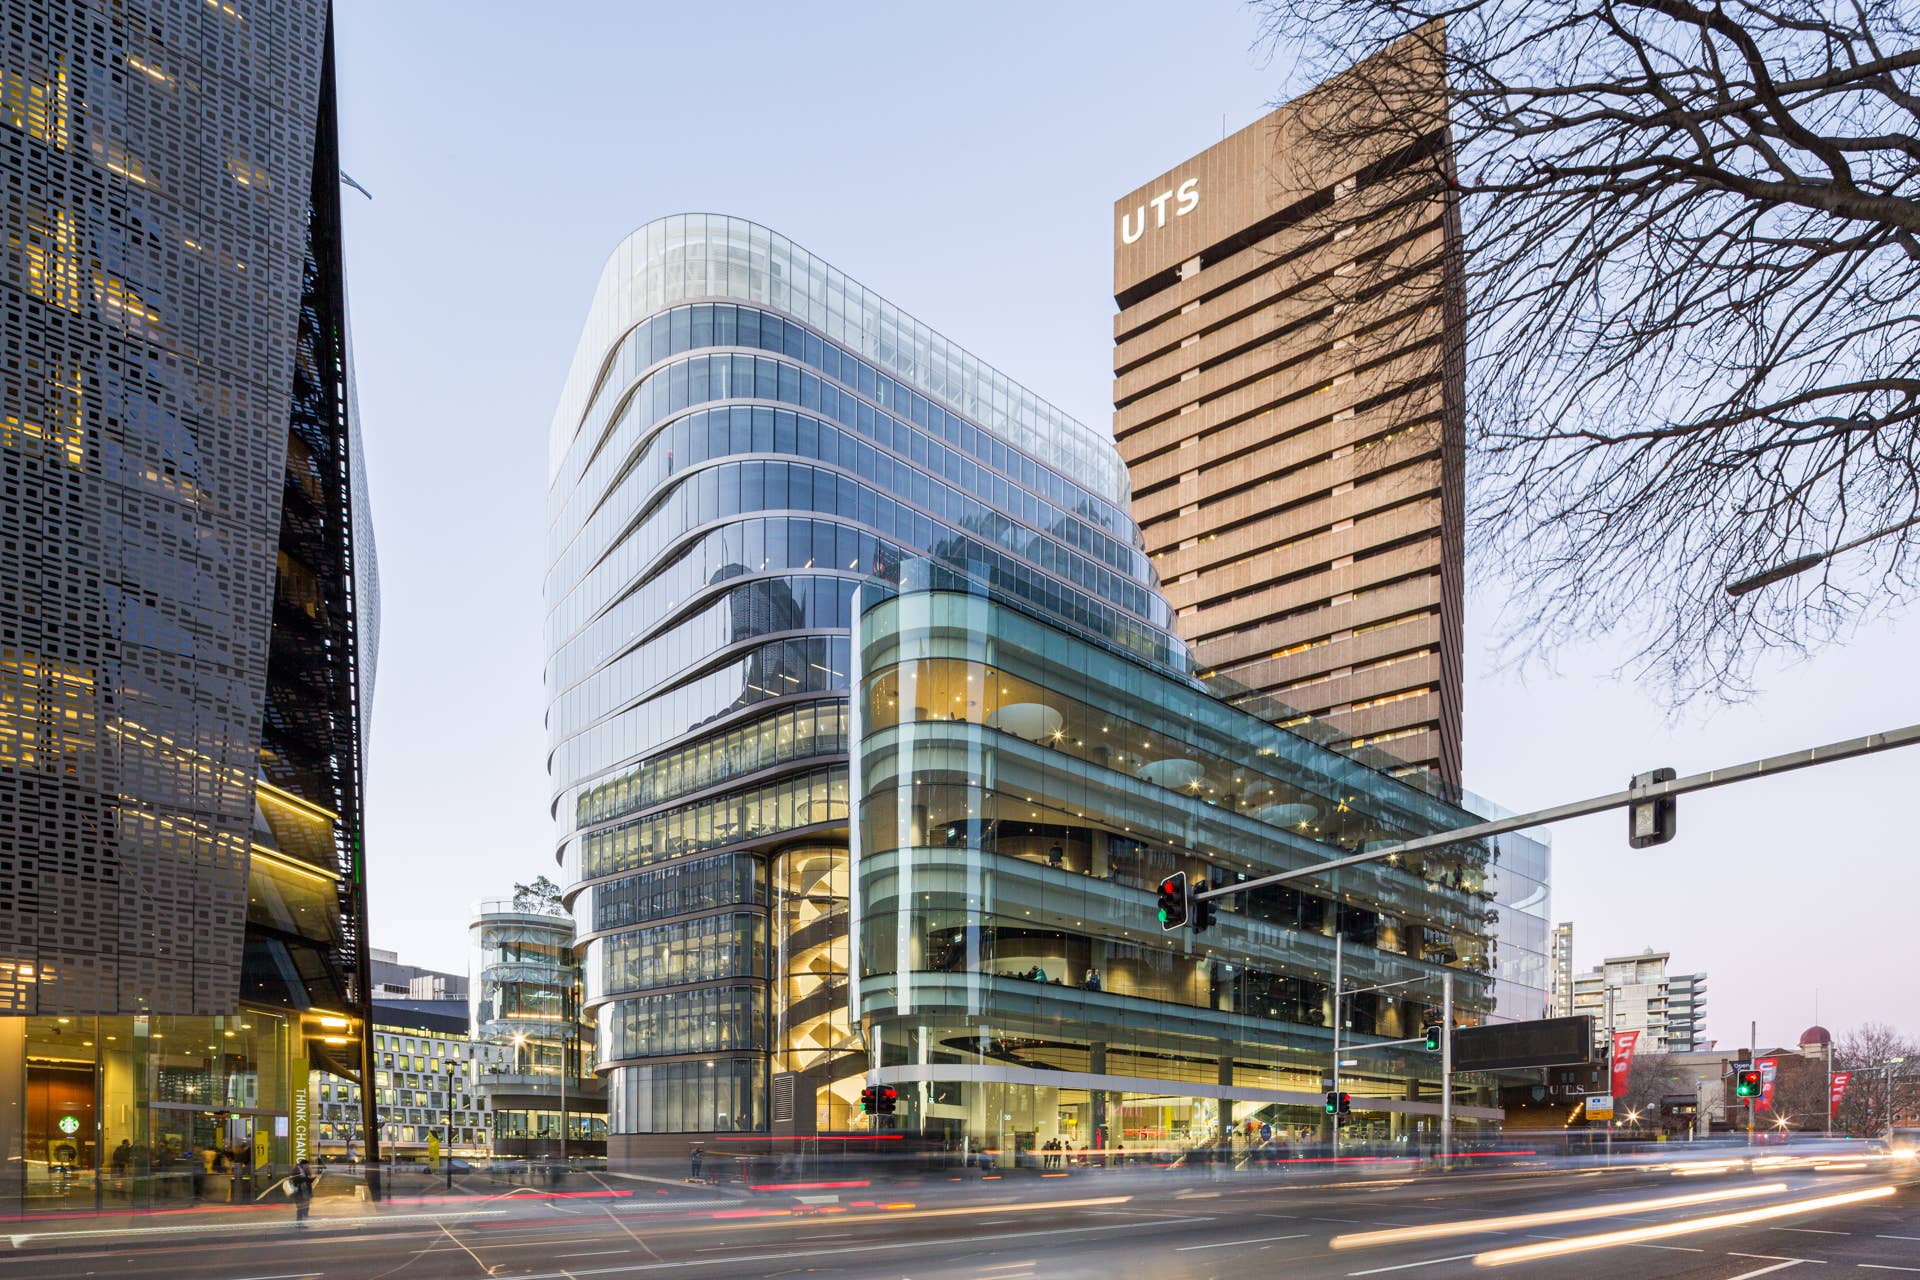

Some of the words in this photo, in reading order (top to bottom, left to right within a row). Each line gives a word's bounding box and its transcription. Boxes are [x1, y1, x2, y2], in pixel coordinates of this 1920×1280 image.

[1122, 177, 1200, 245] UTS
[1614, 1035, 1634, 1073] UTS
[1733, 1063, 1750, 1071] Open
[1549, 1084, 1584, 1095] UTS
[1831, 1076, 1848, 1102] UTS
